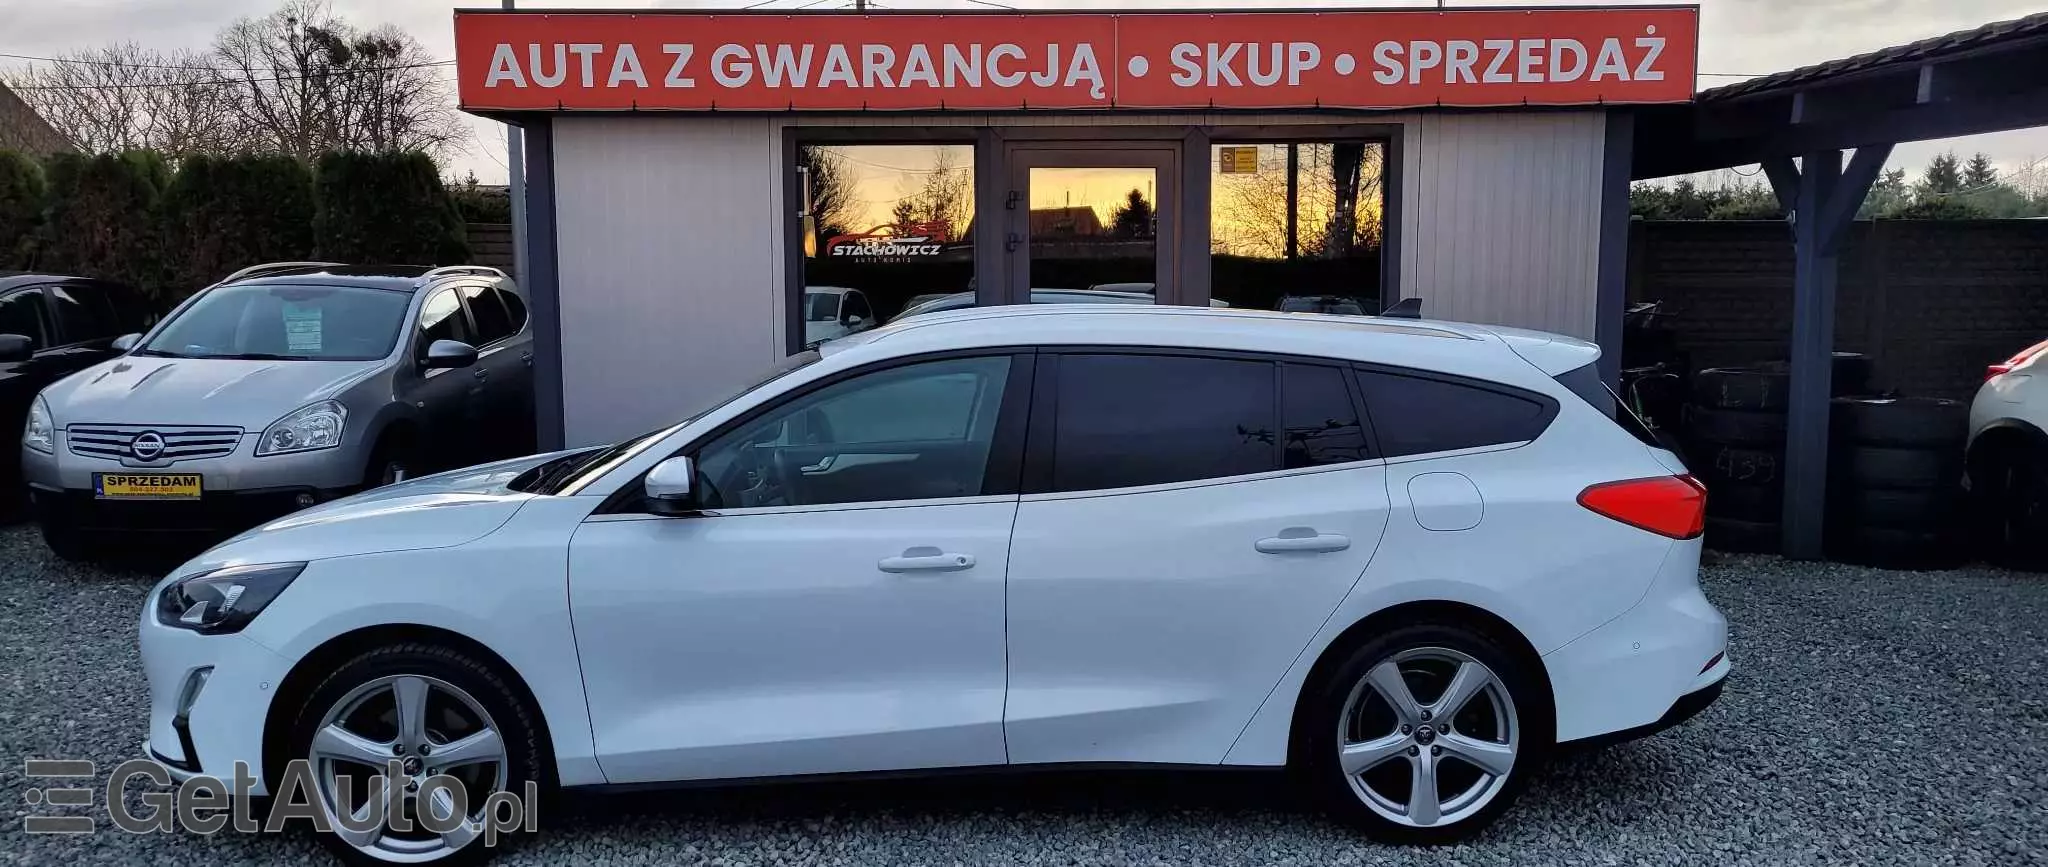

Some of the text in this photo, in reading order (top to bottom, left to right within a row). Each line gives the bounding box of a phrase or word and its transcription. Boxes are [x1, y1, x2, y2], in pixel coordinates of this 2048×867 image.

[485, 23, 1666, 100] AUTA Z GWARANCJĄ SKUP SPRZEDAŻ
[833, 245, 941, 256] STACHOWICZ
[108, 476, 196, 487] SPRZEDAM
